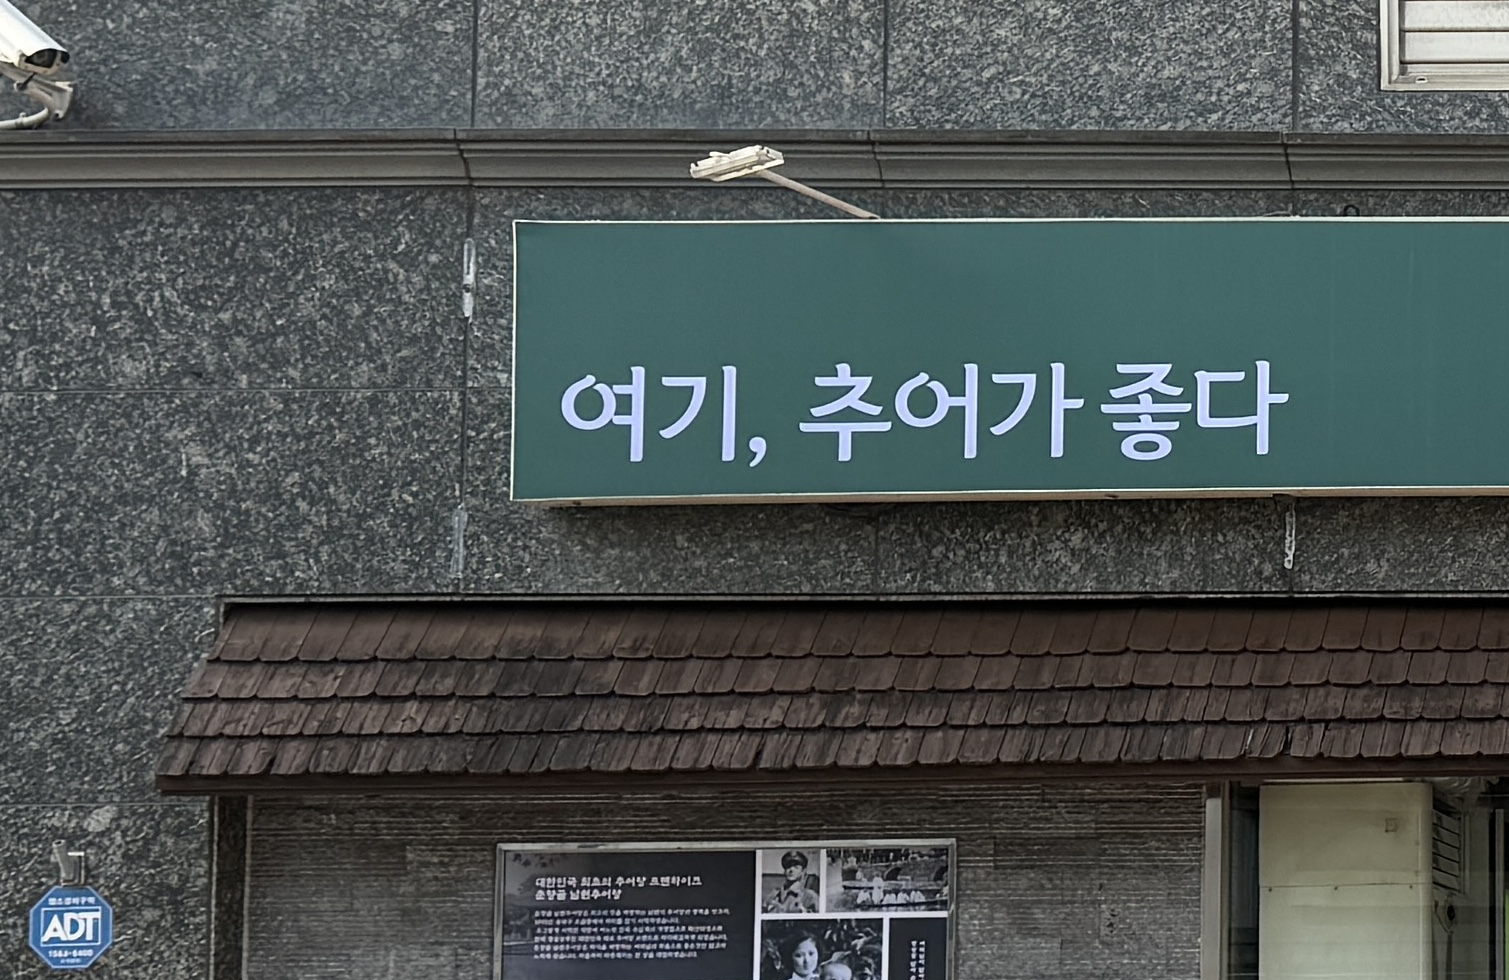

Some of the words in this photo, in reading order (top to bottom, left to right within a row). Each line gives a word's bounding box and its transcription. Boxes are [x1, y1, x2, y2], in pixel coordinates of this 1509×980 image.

[561, 364, 767, 466] 여기,
[799, 362, 1085, 462] 추어가
[1101, 360, 1290, 462] 좋다
[41, 911, 101, 942] ADT
